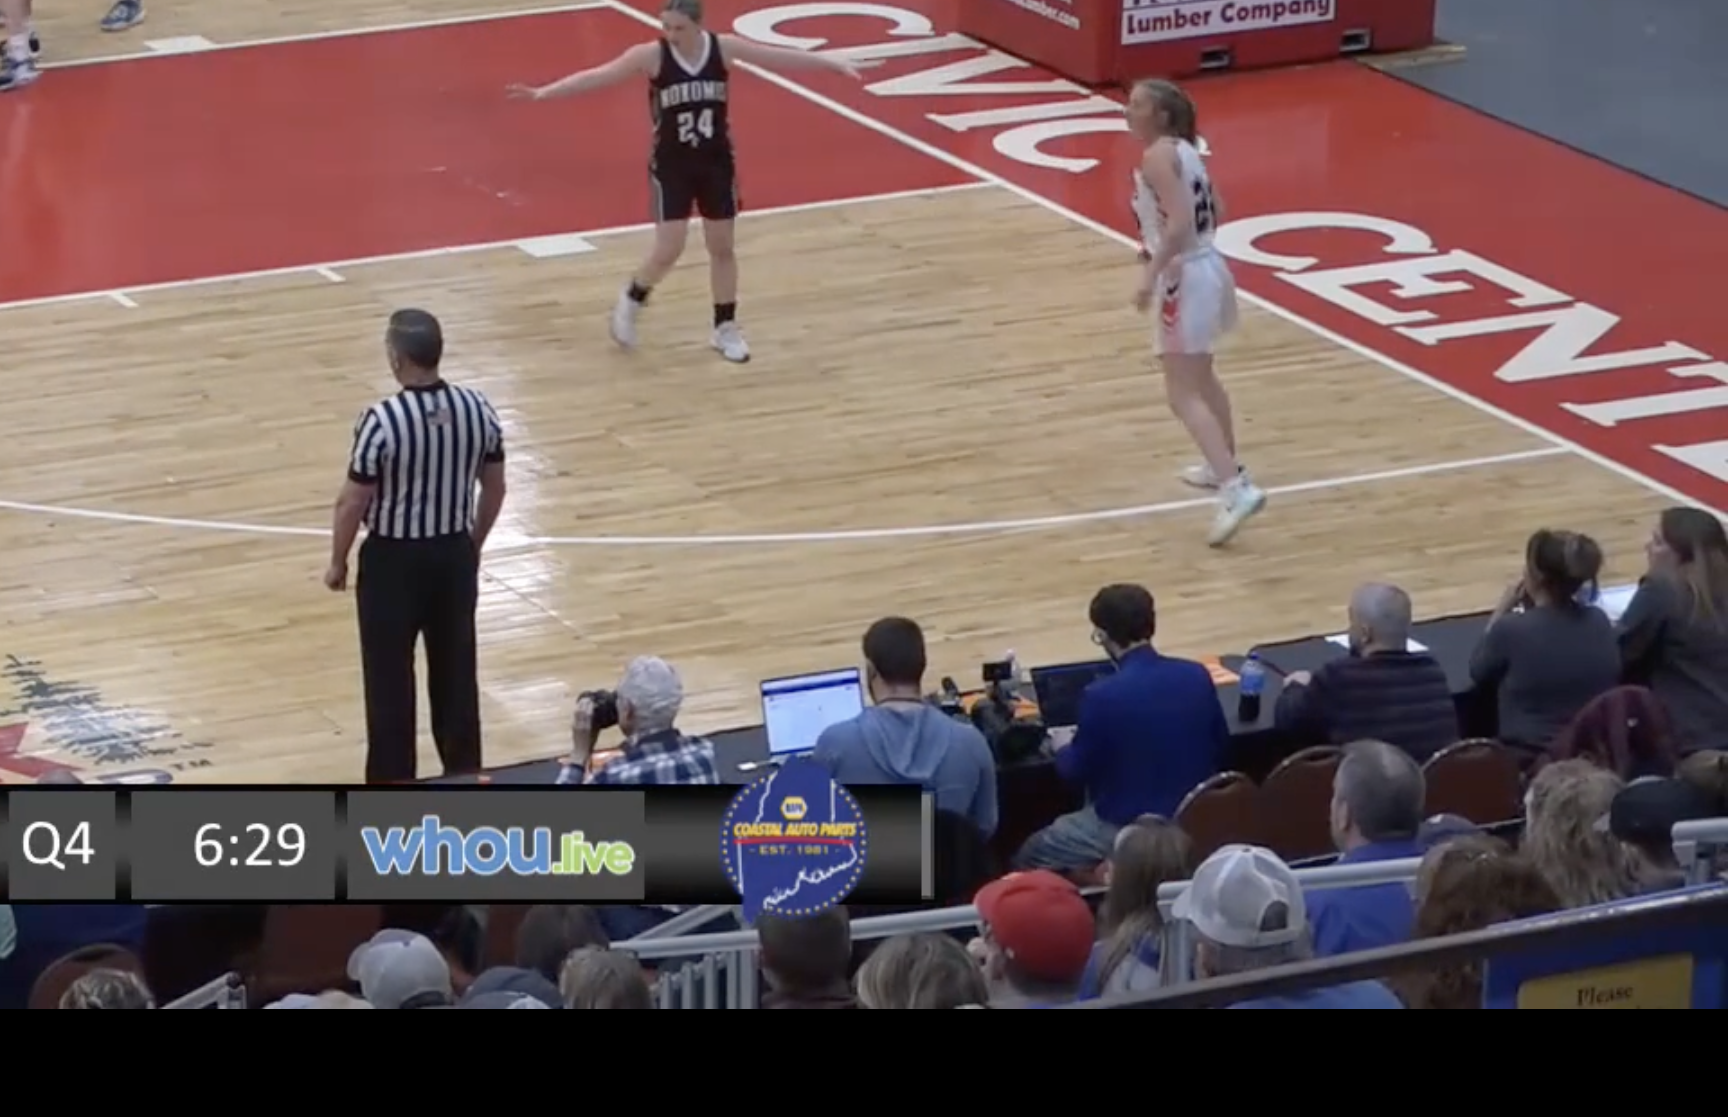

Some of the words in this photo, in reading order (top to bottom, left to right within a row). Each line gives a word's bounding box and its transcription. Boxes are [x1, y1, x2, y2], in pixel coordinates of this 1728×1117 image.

[1126, 7, 1212, 35] Lumber
[731, 1, 1132, 174] CIVIC
[676, 108, 714, 143] 24
[1214, 211, 1728, 486] CENT
[1576, 984, 1634, 1007] Please
